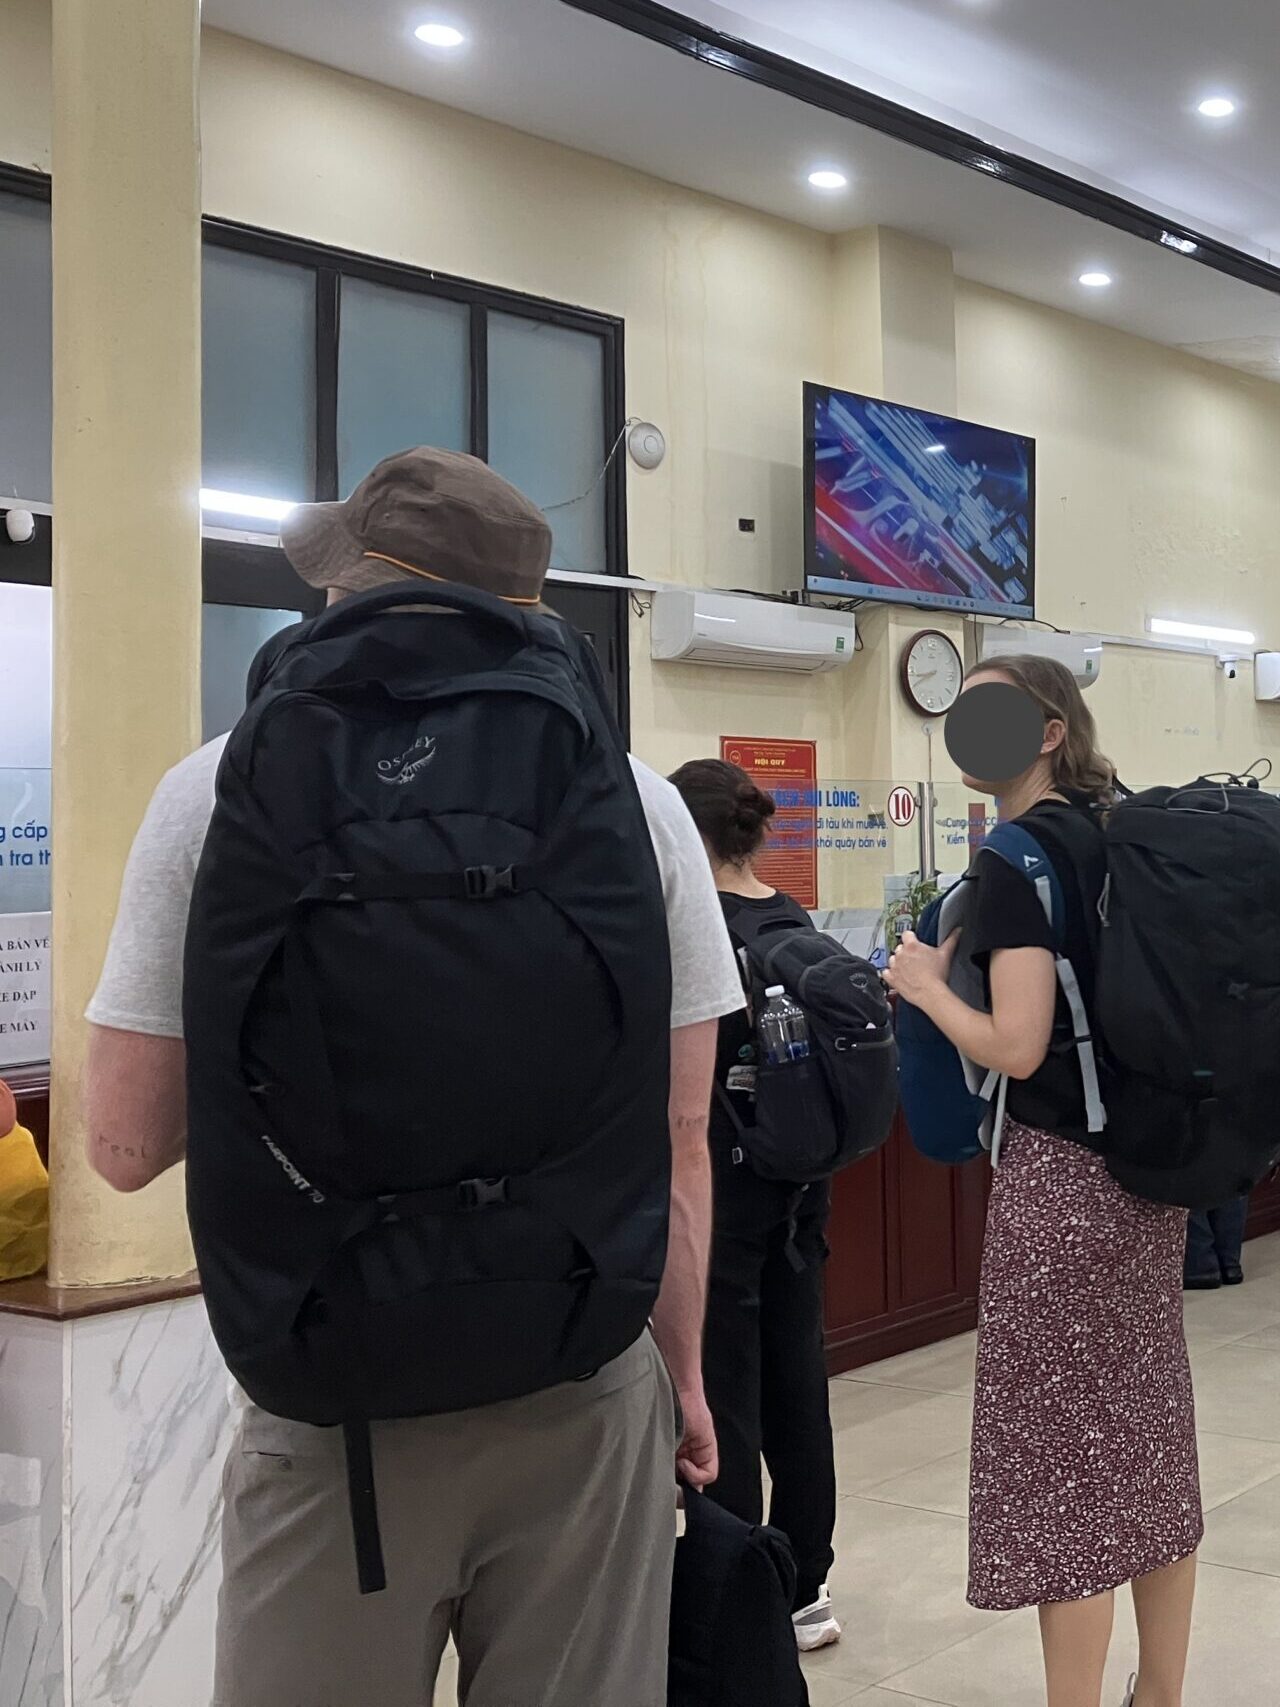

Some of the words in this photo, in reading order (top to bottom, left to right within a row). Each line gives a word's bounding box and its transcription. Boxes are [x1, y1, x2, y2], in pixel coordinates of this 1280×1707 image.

[826, 786, 860, 808] LÒNG:
[894, 793, 912, 820] 10
[12, 819, 48, 842] cấp
[841, 816, 854, 830] khi
[10, 849, 33, 866] tra
[7, 938, 31, 951] BÁN
